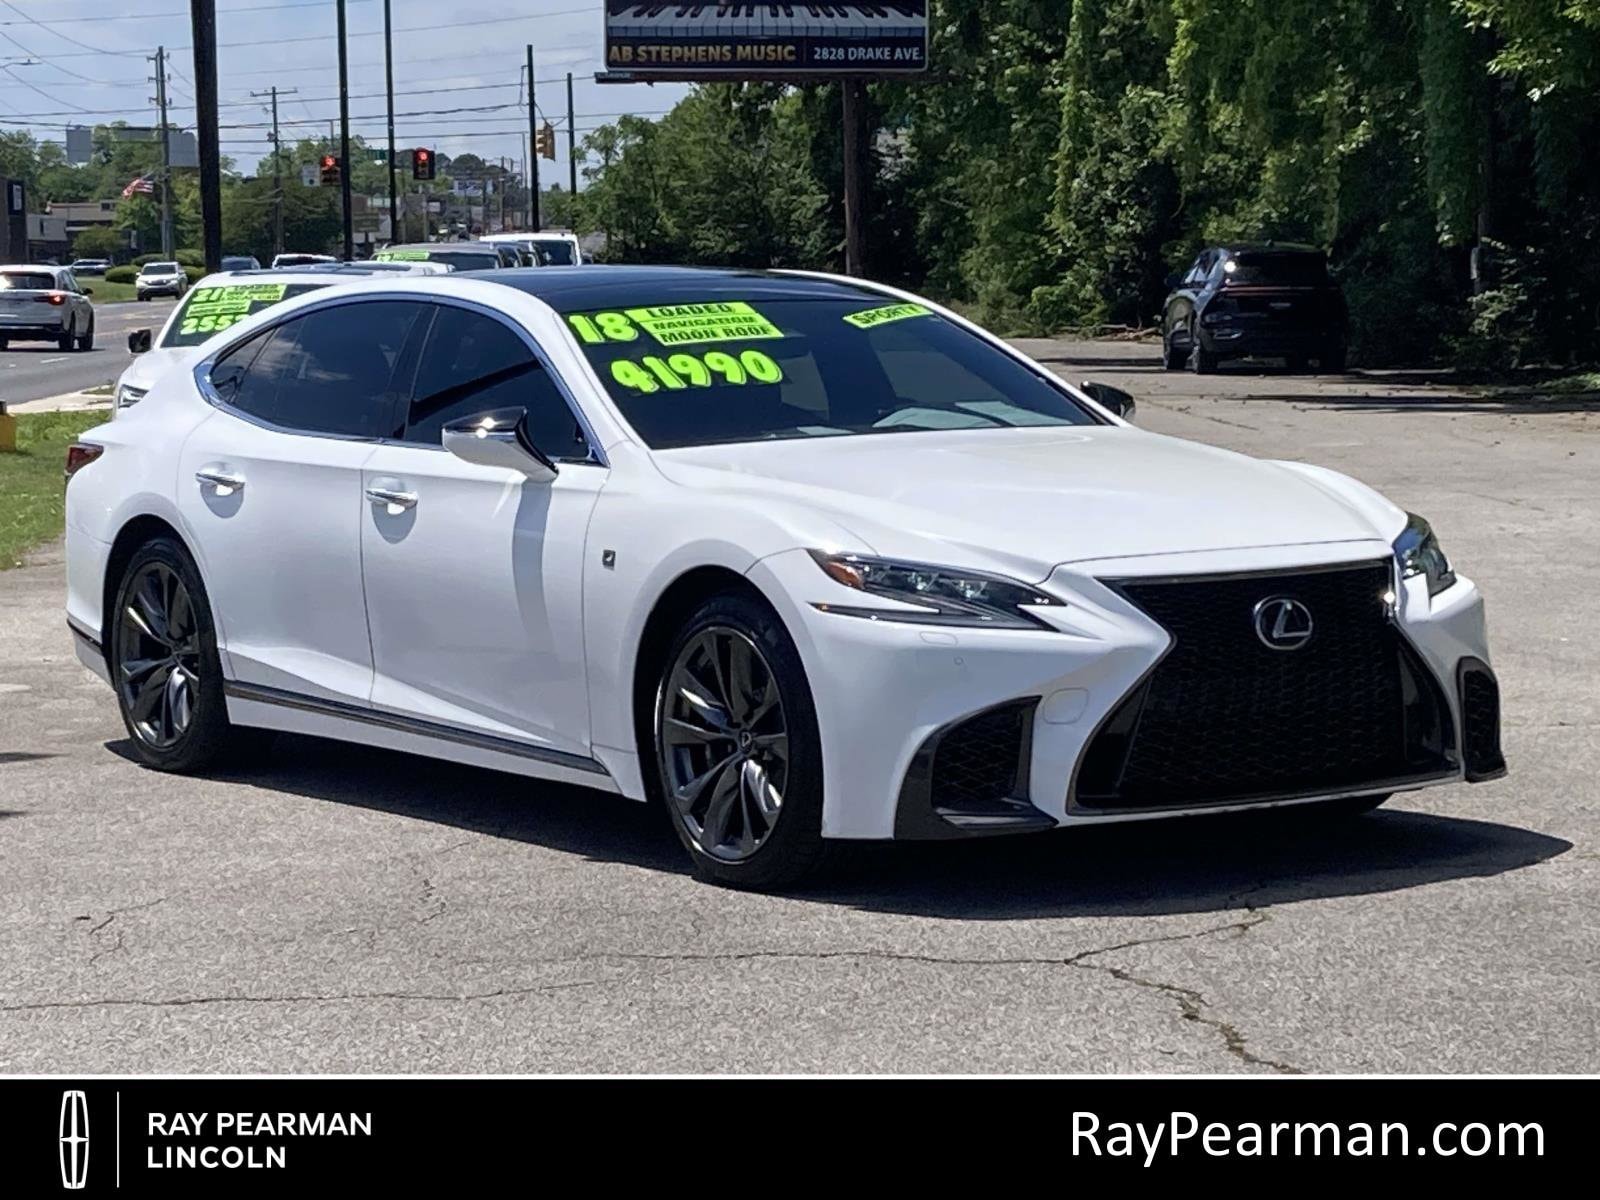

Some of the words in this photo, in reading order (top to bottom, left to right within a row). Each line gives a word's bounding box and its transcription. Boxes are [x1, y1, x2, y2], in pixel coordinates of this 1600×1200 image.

[608, 46, 633, 62] AB
[636, 45, 732, 62] STEPHENS
[735, 46, 796, 61] MUSIC
[813, 47, 845, 60] 2828
[848, 47, 891, 60] DRAKE
[193, 288, 224, 302] 21
[646, 304, 735, 318] LOADED
[851, 305, 920, 324] SPORTY
[569, 312, 638, 343] 18
[652, 315, 757, 330] NAVIGATION
[661, 328, 718, 343] MOON
[611, 350, 783, 393] 41990
